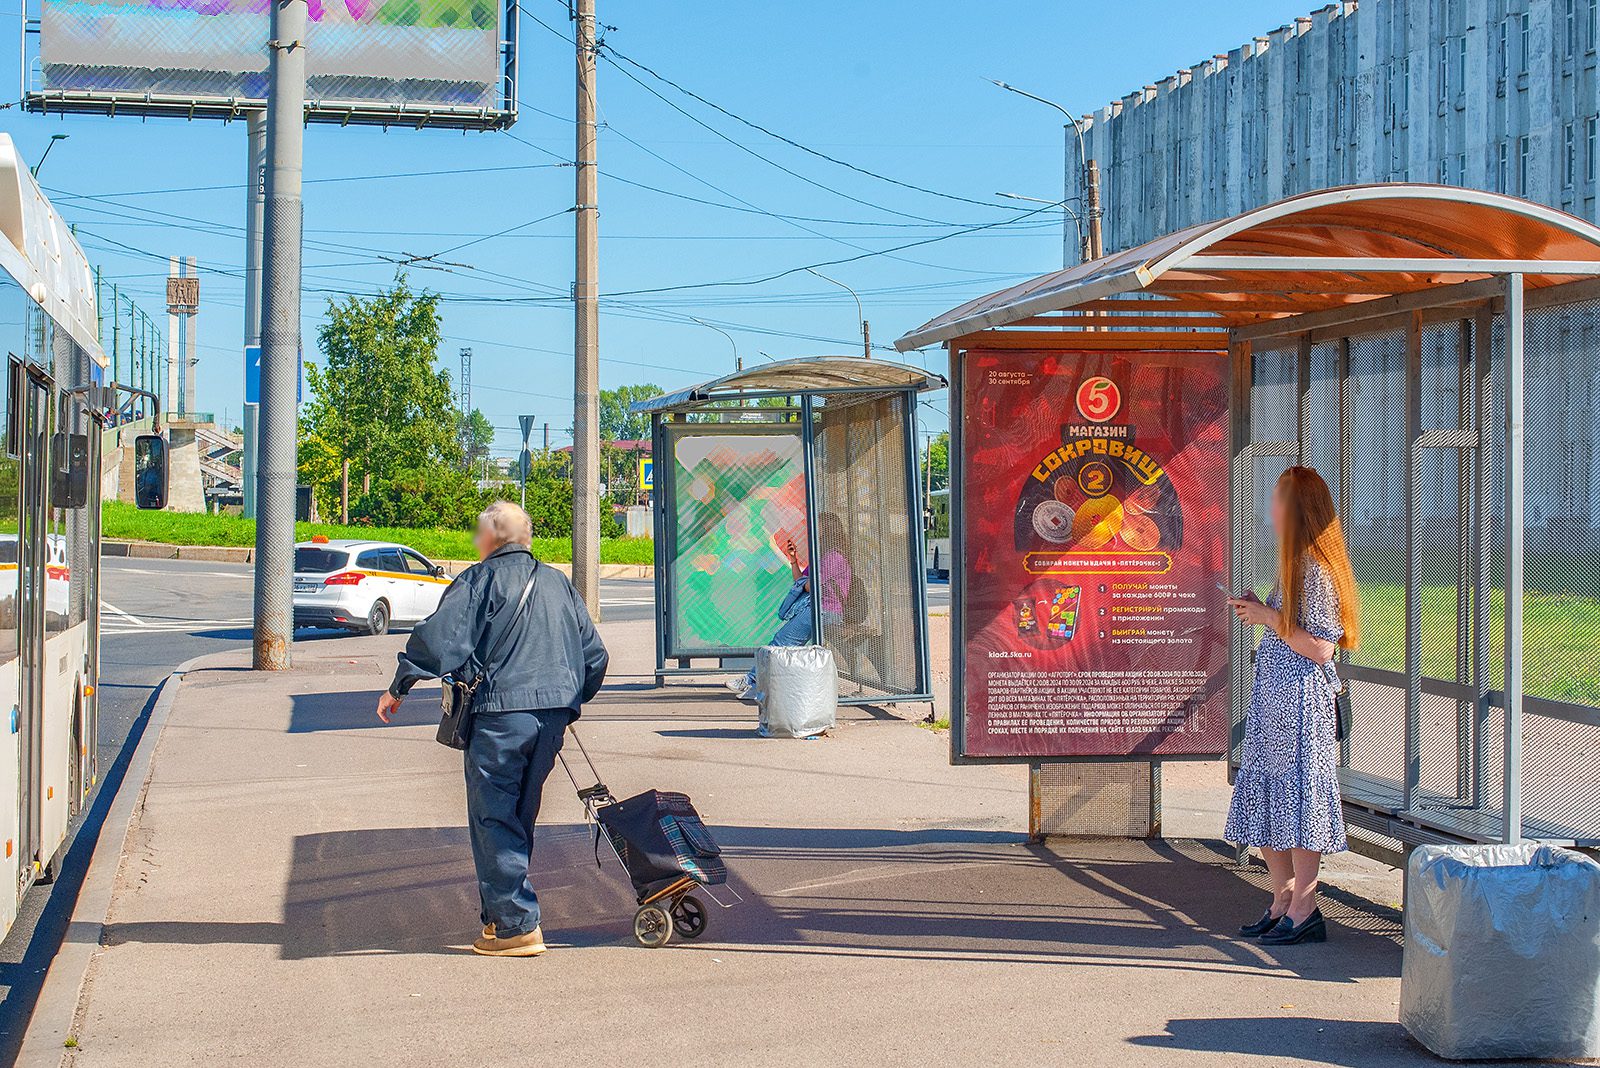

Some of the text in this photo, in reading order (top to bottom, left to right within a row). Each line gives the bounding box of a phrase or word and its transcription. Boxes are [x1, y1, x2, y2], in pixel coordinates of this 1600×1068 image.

[998, 378, 1030, 386] сентября
[1088, 380, 1111, 414] 5
[1069, 425, 1127, 438] МАГАЗИН
[1031, 438, 1164, 486] СОКРОВИЩ
[1087, 470, 1104, 490] 2
